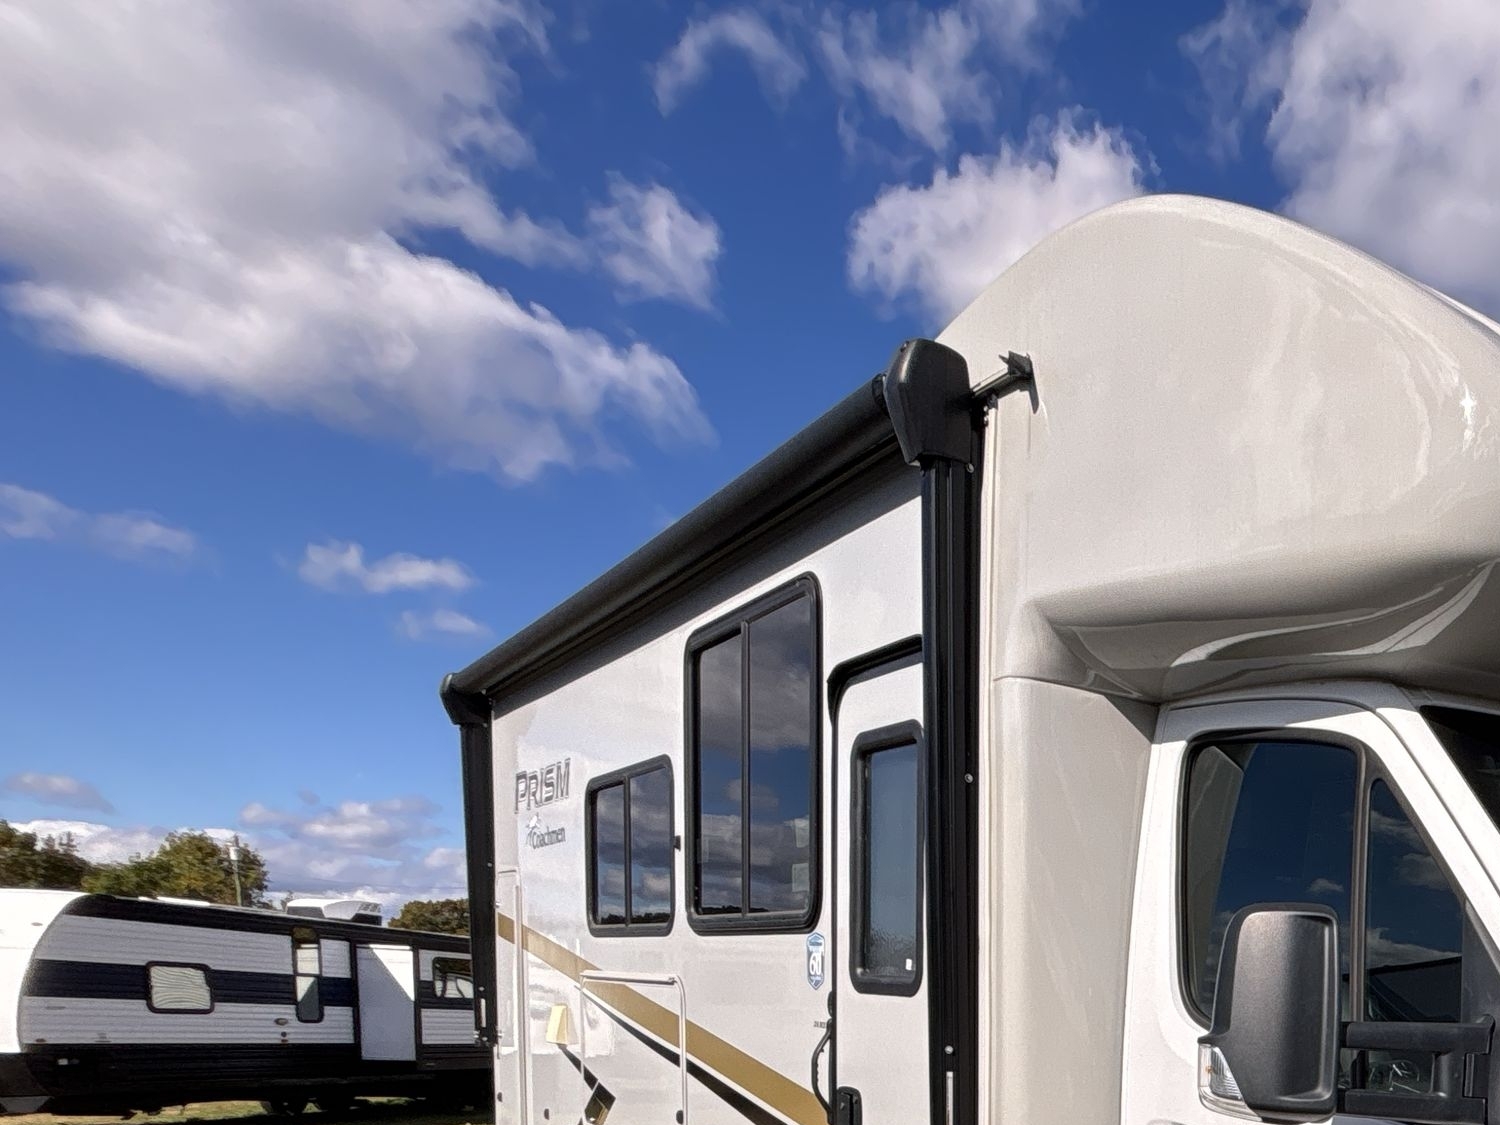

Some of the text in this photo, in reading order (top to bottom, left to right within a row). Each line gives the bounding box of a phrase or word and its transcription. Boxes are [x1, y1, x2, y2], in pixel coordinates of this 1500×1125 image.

[515, 758, 571, 814] PRISM
[532, 826, 566, 849] Coachmen
[809, 952, 822, 976] 60
